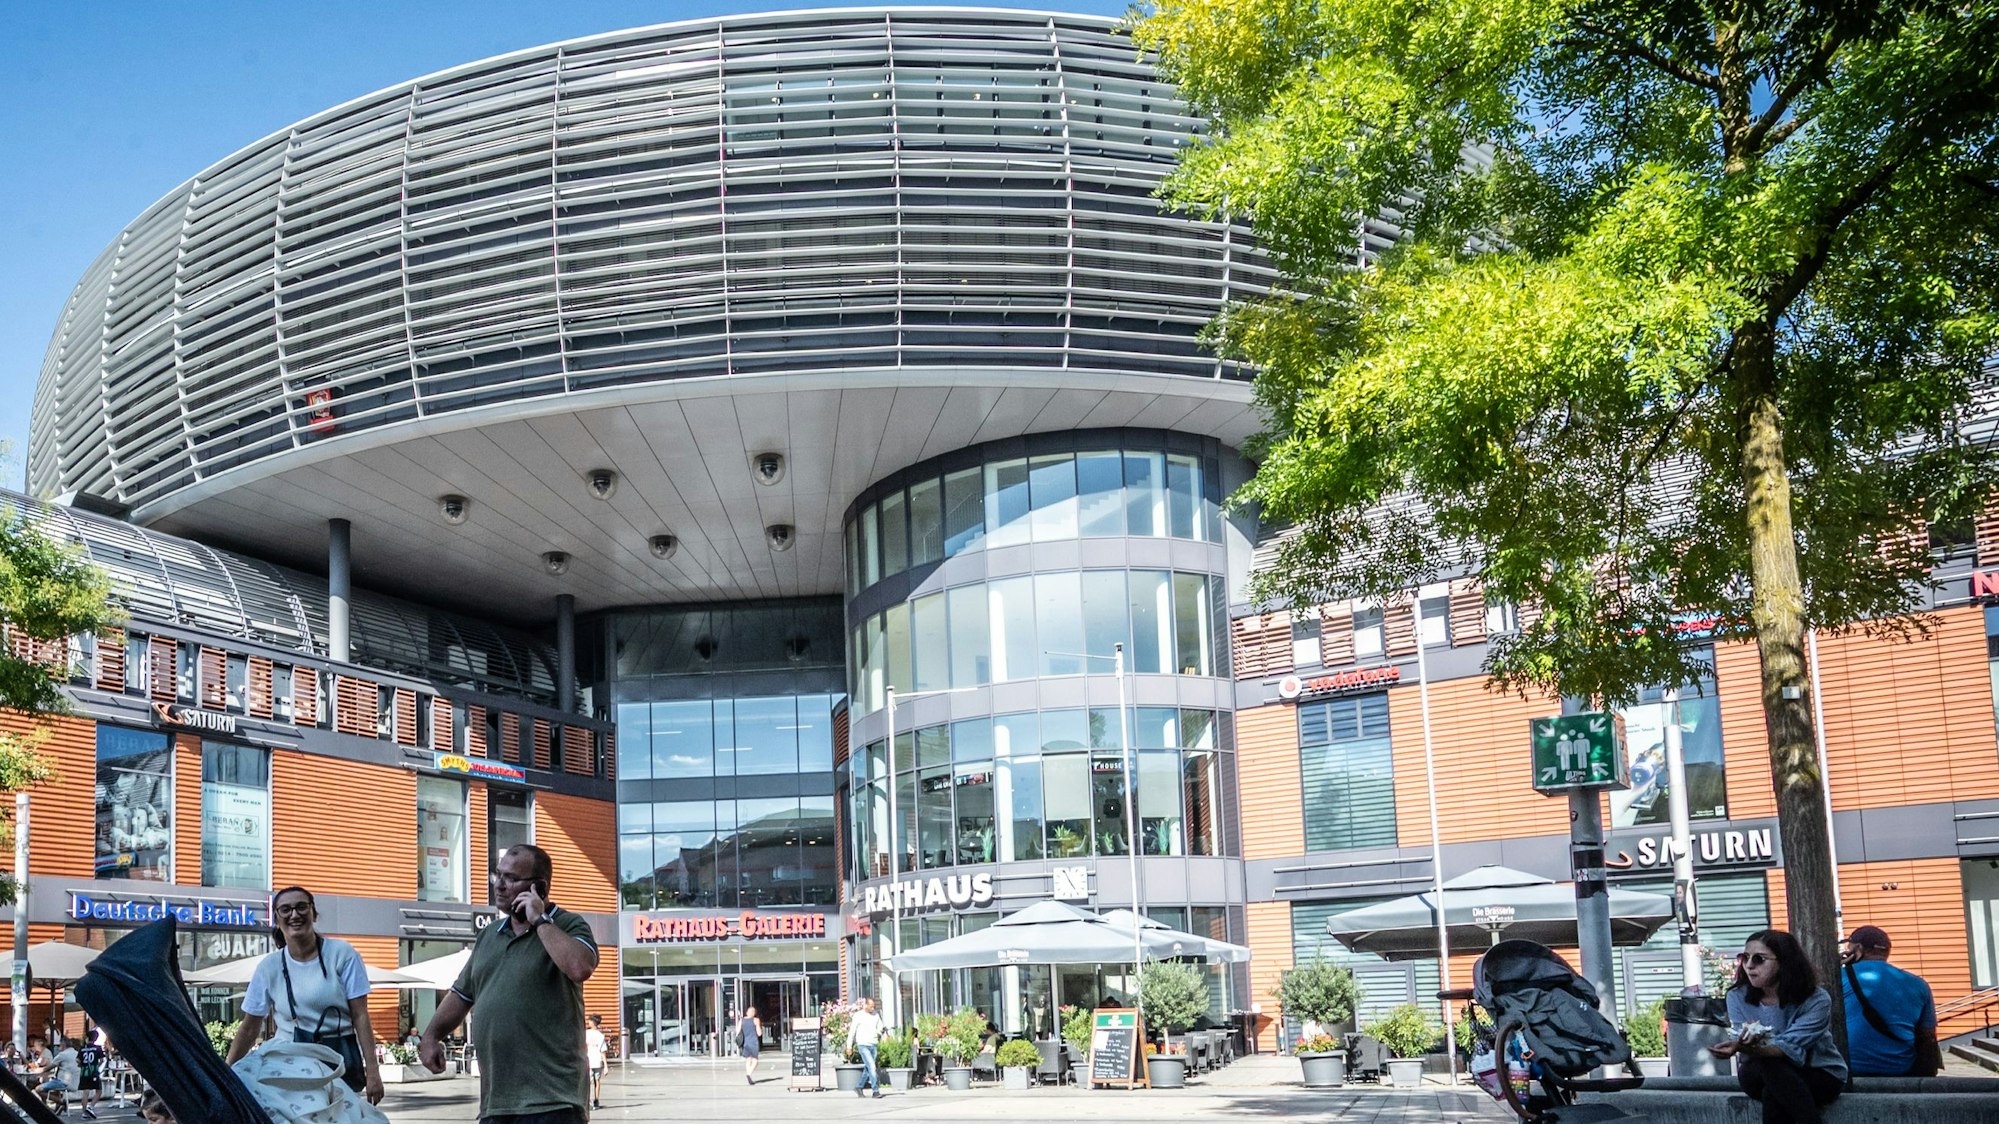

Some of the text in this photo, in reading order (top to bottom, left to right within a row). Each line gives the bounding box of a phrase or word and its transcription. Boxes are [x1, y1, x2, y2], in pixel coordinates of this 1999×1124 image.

[1307, 665, 1400, 691] vodafone
[184, 708, 236, 733] SATURN
[440, 757, 469, 771] SMYTHS
[865, 873, 993, 913] RATHAUS
[72, 893, 256, 925] Deutsche Bank
[1472, 906, 1515, 917] Die Brasserie
[83, 1052, 94, 1064] 20
